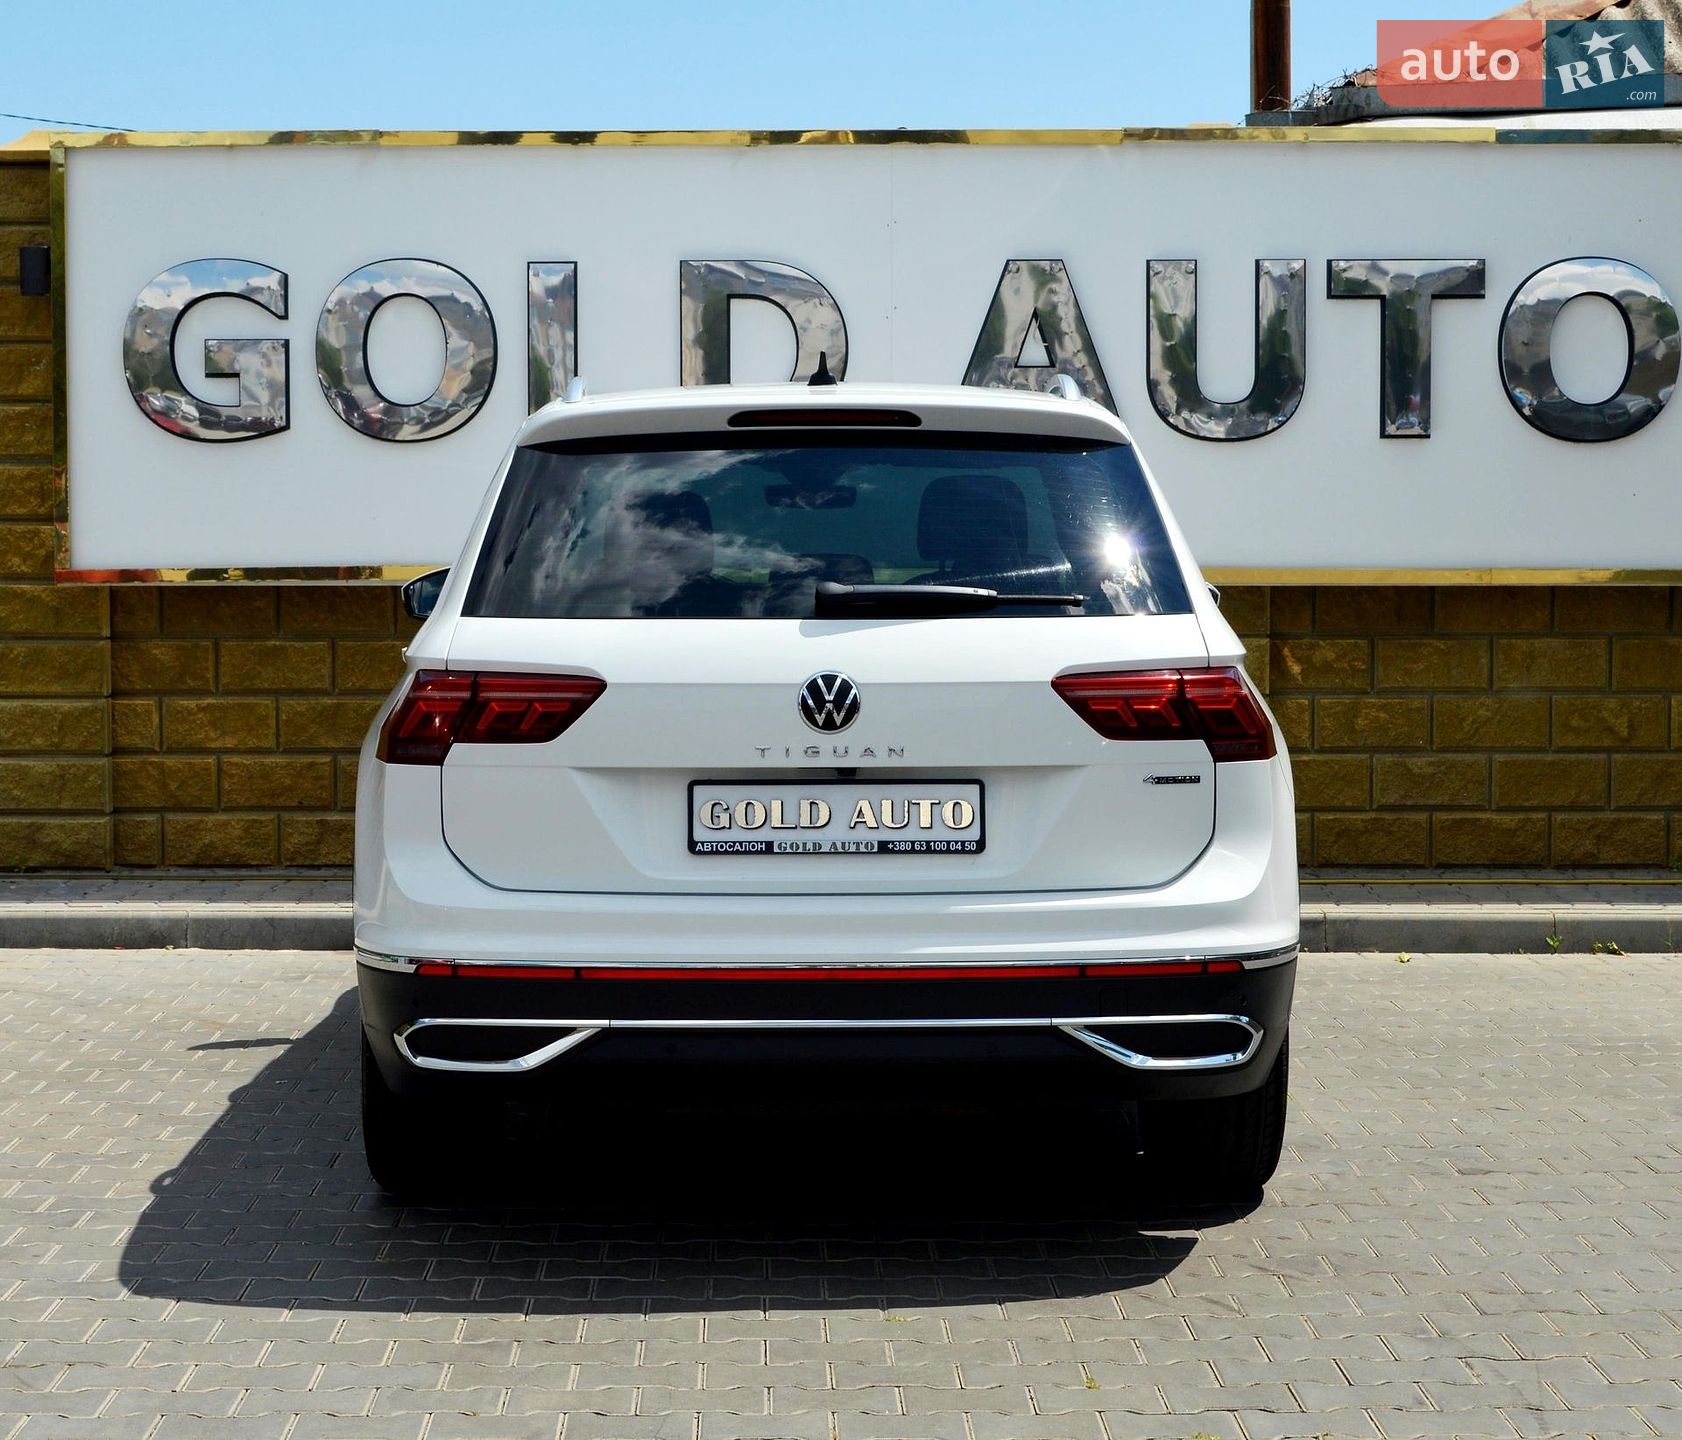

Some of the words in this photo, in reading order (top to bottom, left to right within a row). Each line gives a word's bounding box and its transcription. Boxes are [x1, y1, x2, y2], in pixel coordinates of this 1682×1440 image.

[961, 256, 1682, 443] AUTO
[754, 745, 905, 759] TIGUAN
[700, 798, 832, 830] GOLD
[849, 798, 975, 830] AUTO
[695, 841, 766, 852] АВТОСАЛОН
[776, 841, 823, 852] GOLD
[828, 841, 876, 852] AUTO
[887, 841, 912, 851] +380
[914, 841, 928, 851] 63
[929, 841, 948, 851] 100
[949, 841, 963, 851] 04
[964, 841, 977, 851] 50
